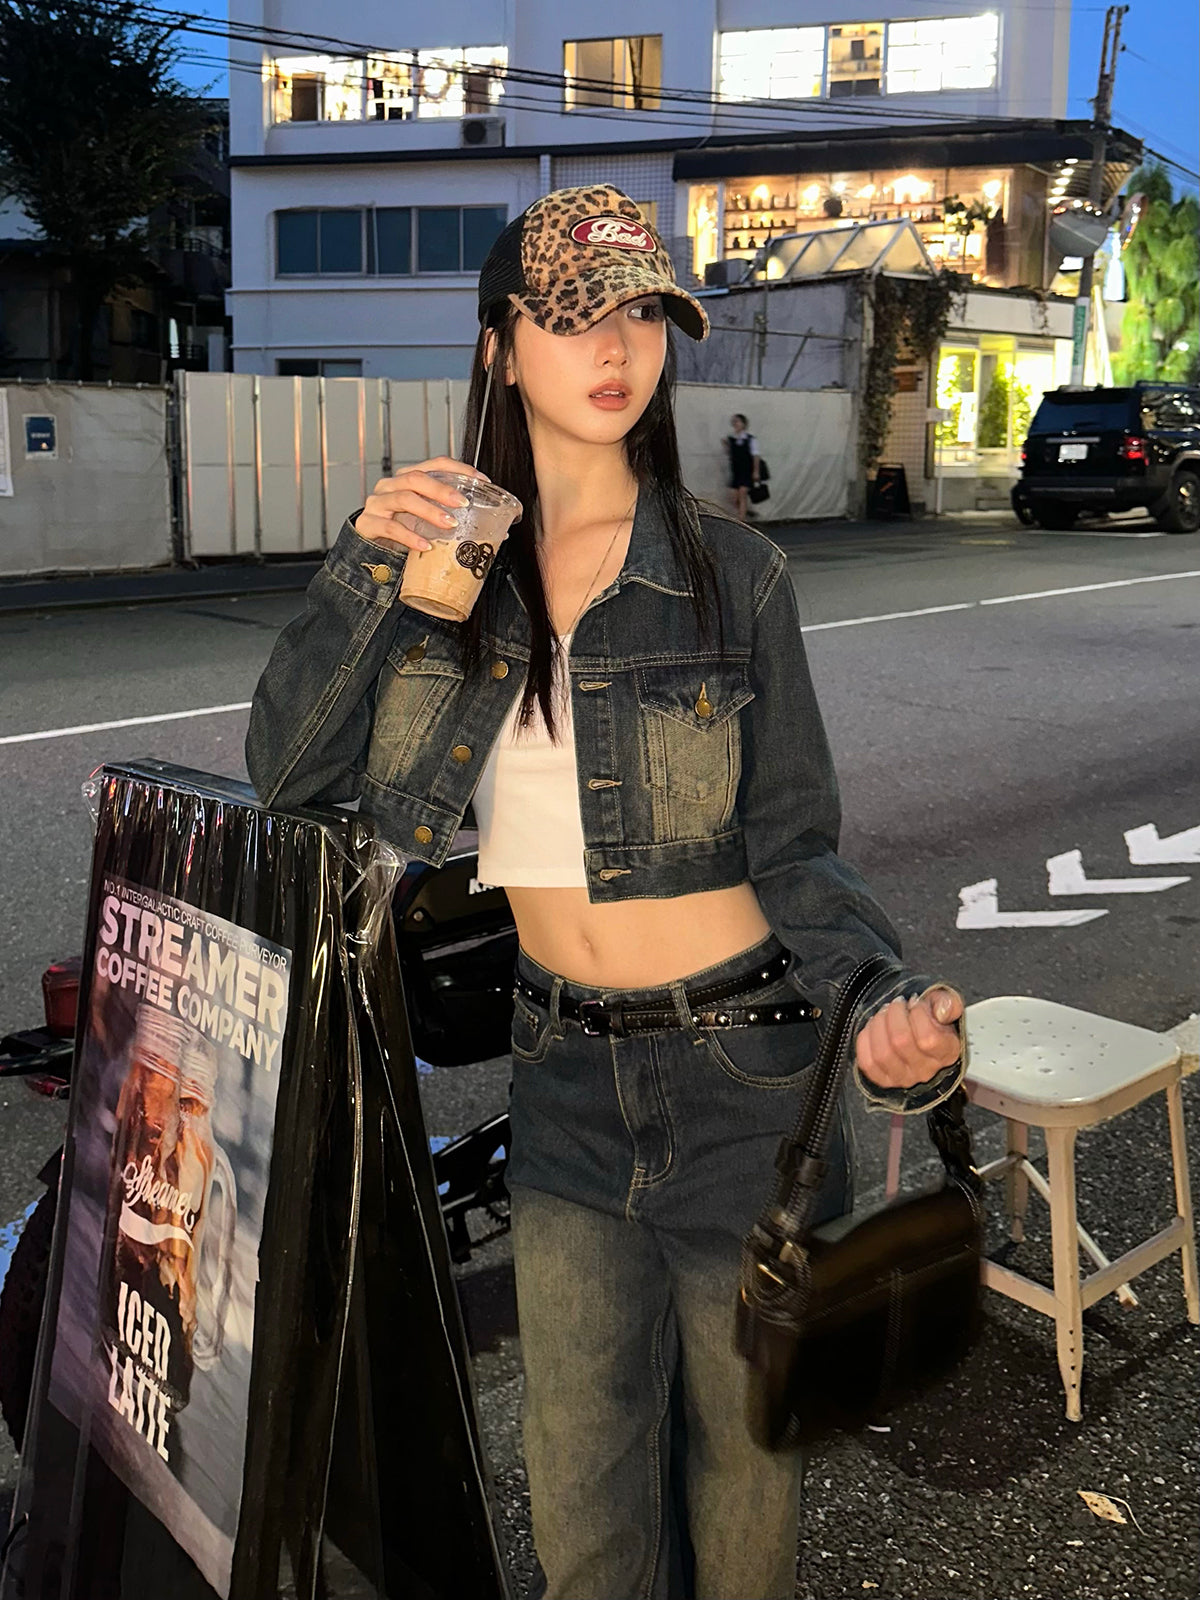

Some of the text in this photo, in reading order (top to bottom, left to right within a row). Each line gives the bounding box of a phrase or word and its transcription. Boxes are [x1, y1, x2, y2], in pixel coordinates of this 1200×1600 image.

[100, 895, 285, 1033] STREAMER
[104, 879, 287, 972] NO.1 INTERGALACTIC CRAFT COFFEE PURVEYOR
[97, 947, 280, 1072] COFFEE COMPANY
[118, 1281, 172, 1381] ICED
[108, 1344, 171, 1462] LATTE
